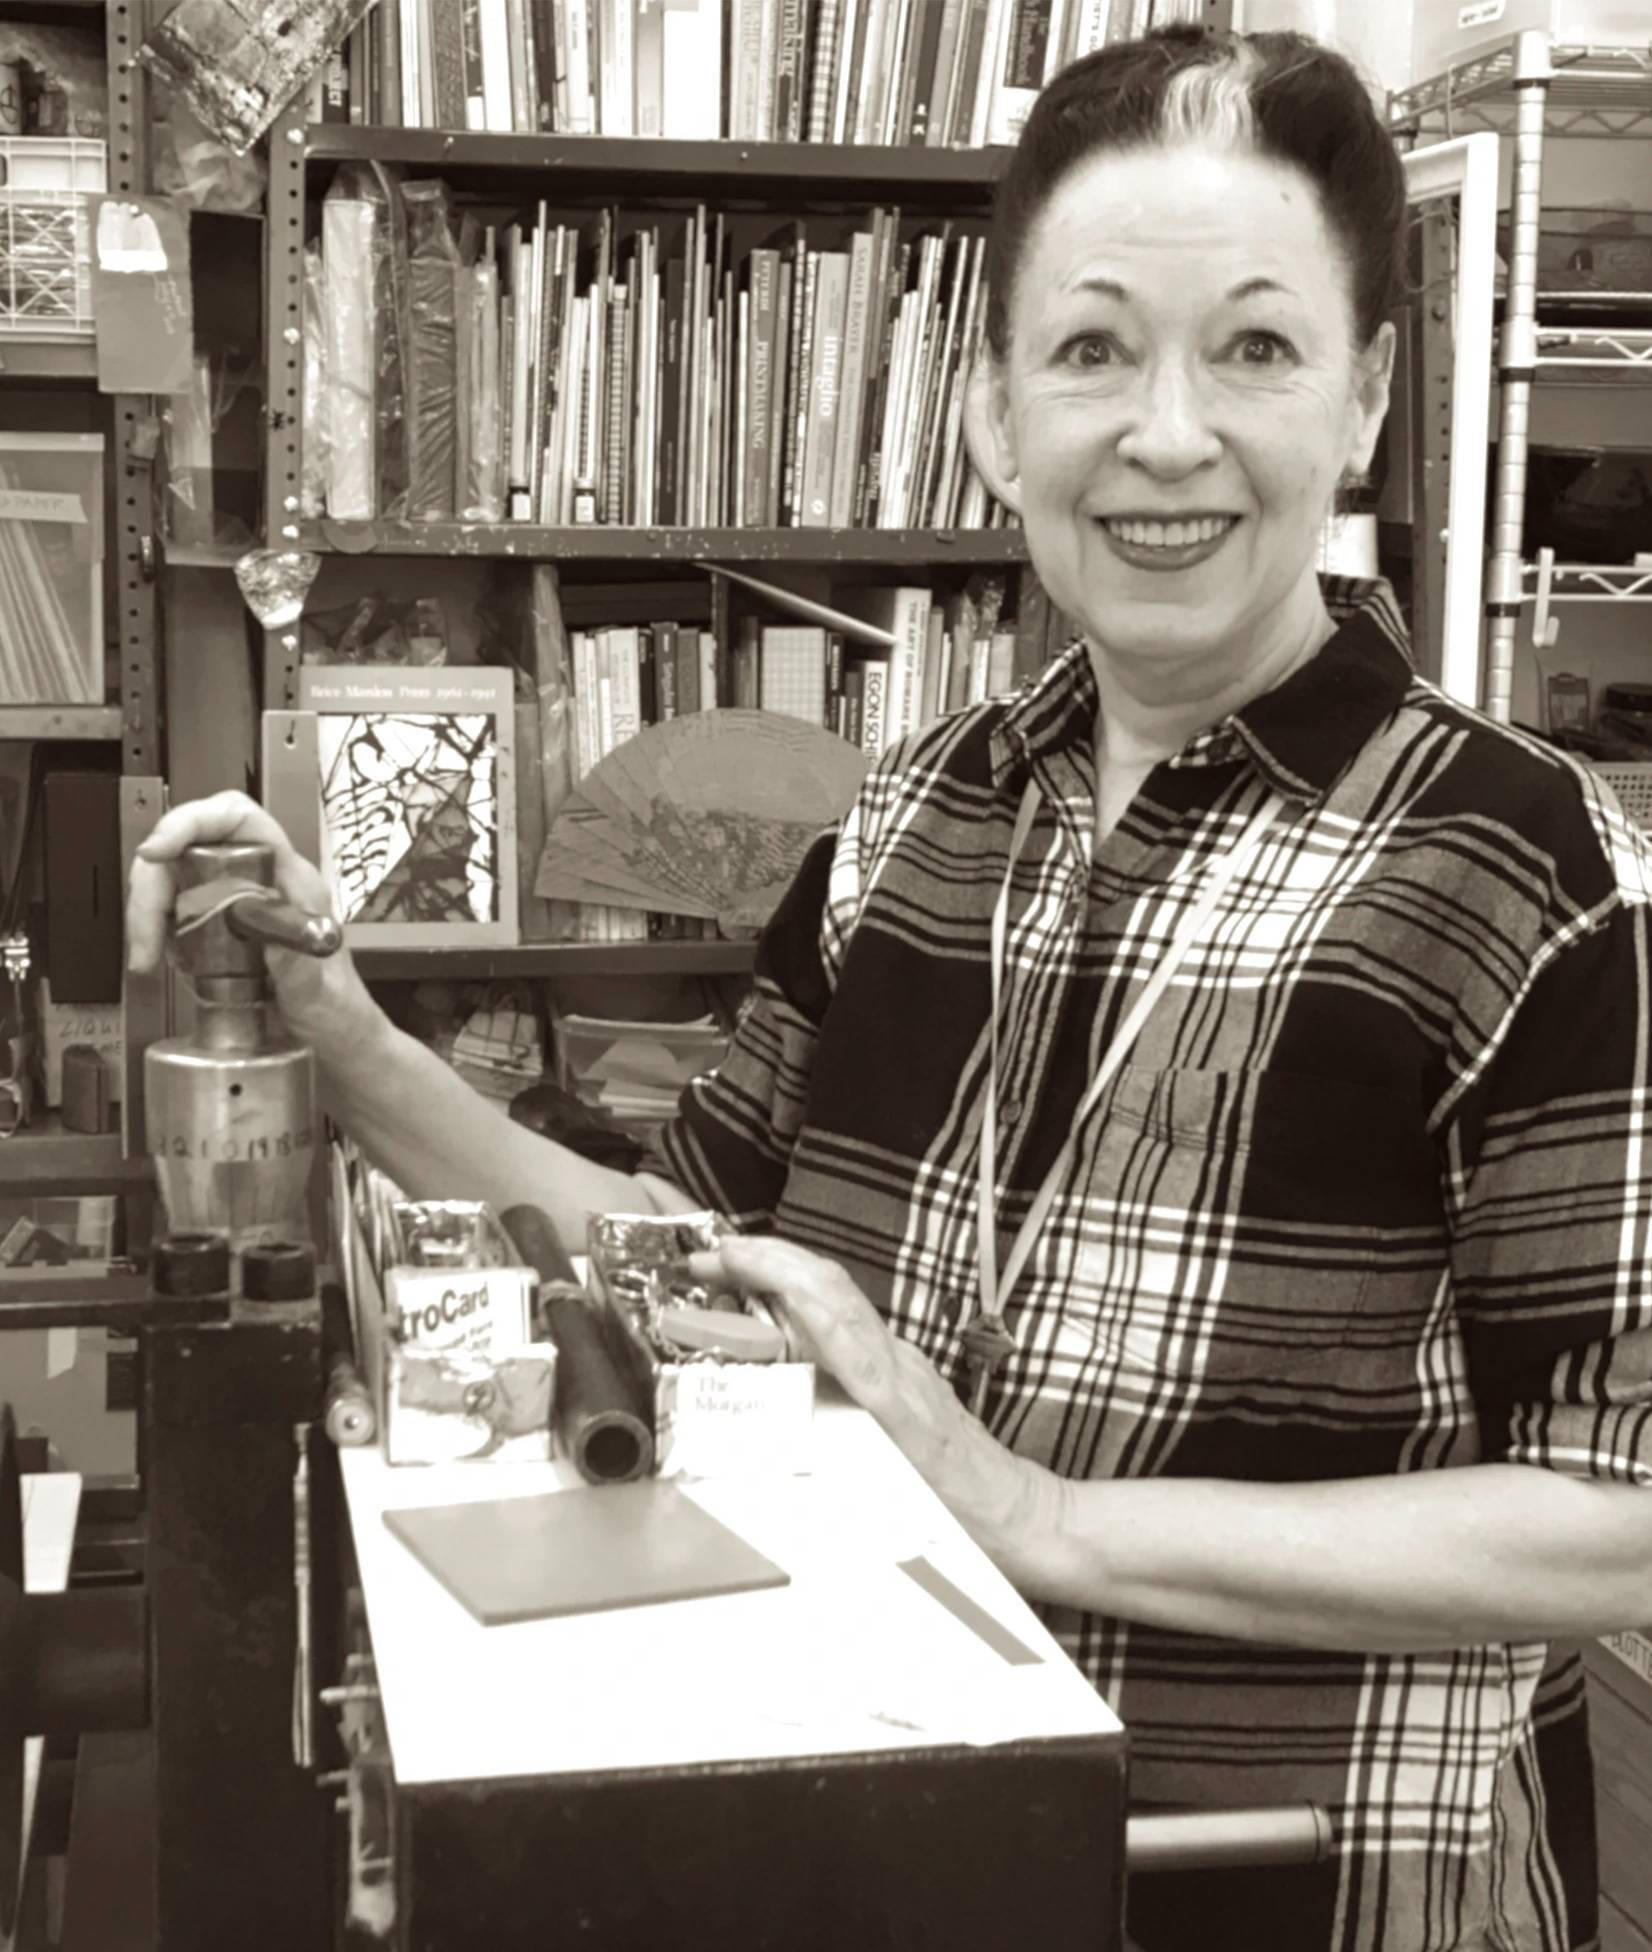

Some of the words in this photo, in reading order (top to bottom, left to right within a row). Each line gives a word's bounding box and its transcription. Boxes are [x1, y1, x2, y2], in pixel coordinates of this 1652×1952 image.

[853, 247, 868, 296] SARAH
[752, 340, 769, 449] PRINTMAKING
[815, 335, 842, 417] intaglio
[867, 672, 882, 720] EGON
